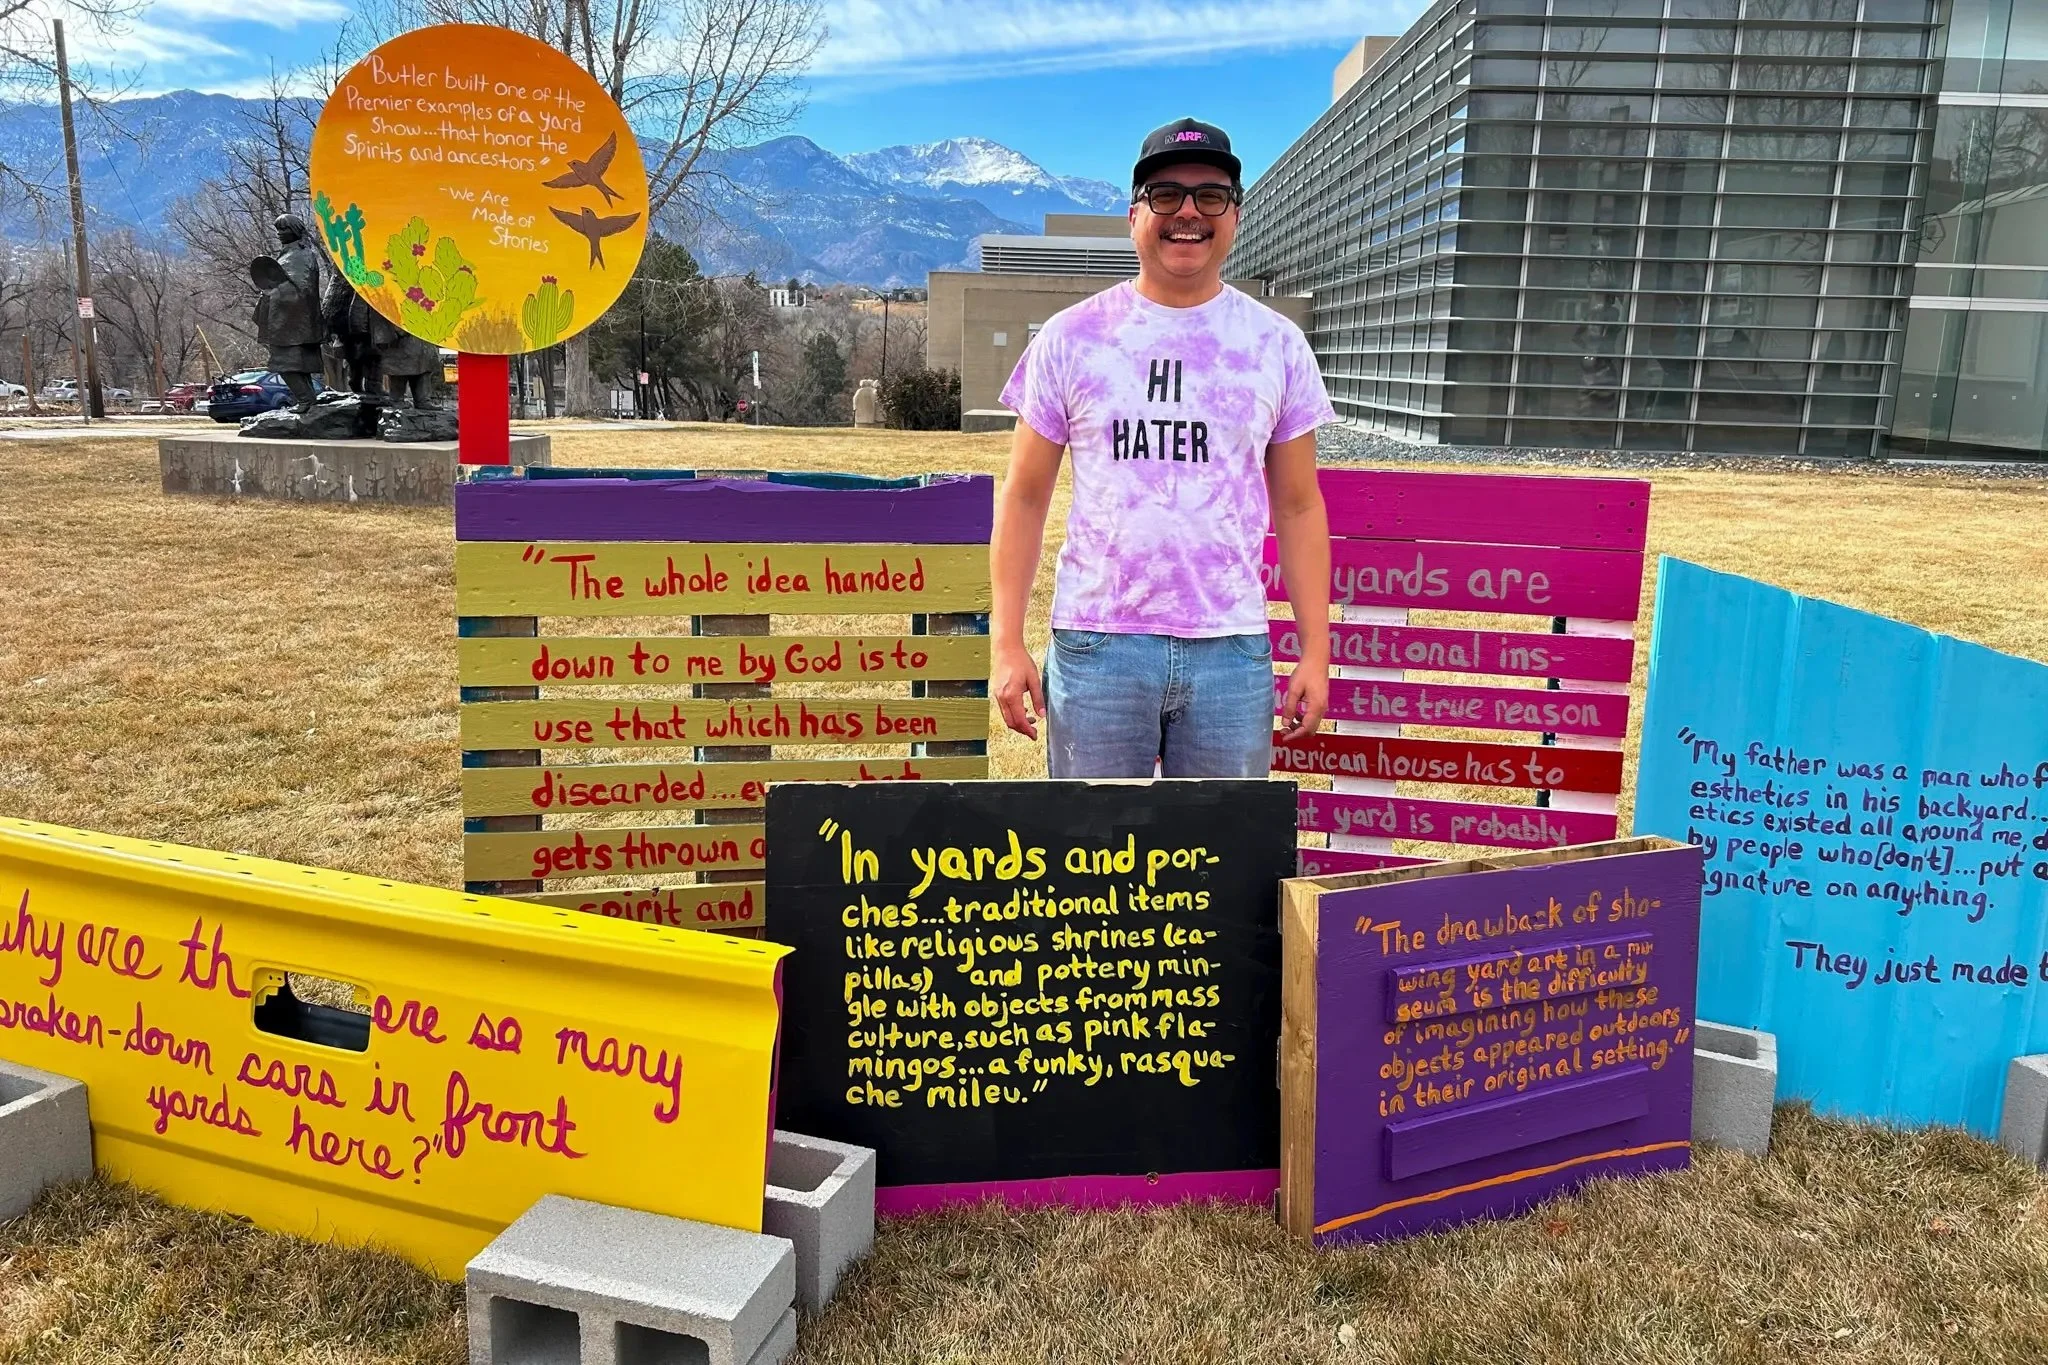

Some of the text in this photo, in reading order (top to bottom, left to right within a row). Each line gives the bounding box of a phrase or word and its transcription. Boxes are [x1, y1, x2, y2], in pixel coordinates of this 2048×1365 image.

[361, 54, 586, 112] "Butler built one of the
[346, 85, 412, 111] Premier
[417, 99, 492, 121] examples
[539, 112, 581, 133] yard
[344, 134, 550, 172] Spirits and ancestors."
[483, 128, 535, 148] honor
[537, 135, 568, 155] the
[1164, 131, 1210, 144] MARFA
[472, 207, 536, 229] Made of
[481, 189, 511, 207] Are
[488, 226, 550, 254] Stories
[1147, 359, 1182, 403] HI
[1112, 419, 1209, 463] HATER
[521, 544, 926, 601] "The whole idea handed
[1332, 551, 1450, 606] yards
[1466, 567, 1552, 604] are
[531, 644, 615, 682] down
[627, 641, 670, 675] to
[687, 653, 724, 678] me
[738, 642, 776, 683] by
[784, 643, 842, 676] God
[890, 640, 929, 669] to
[1500, 637, 1565, 671] ins-
[533, 701, 938, 744] use that which has been
[1418, 690, 1483, 721] true
[1495, 693, 1601, 728] reason
[1271, 741, 1565, 786] merican house has to
[1677, 726, 1736, 777] "My
[1744, 741, 1827, 776] father
[1837, 760, 1885, 781] was
[1893, 765, 1908, 780] a
[1922, 770, 1971, 788] man
[1690, 778, 1810, 807] esthetics
[1825, 784, 1848, 811] in
[1862, 787, 1901, 814] his
[1333, 800, 1397, 835] yard
[1409, 805, 1433, 834] is
[1450, 812, 1567, 846] probably
[1688, 805, 1755, 827] etics
[1762, 811, 1852, 836] existed
[1860, 816, 1893, 837] all
[1902, 819, 1983, 842] around
[1992, 832, 2028, 854] me,
[531, 833, 613, 879] gets
[617, 830, 740, 874] thrown
[817, 817, 1221, 900] "In yards and por-
[1688, 825, 1718, 861] by
[1726, 836, 1804, 869] people
[696, 886, 754, 923] and
[1127, 883, 1211, 914] items
[1700, 861, 1995, 924] ignature on anything.
[1354, 887, 1662, 955] "The drawback of sho-
[844, 932, 897, 960] like
[901, 929, 1040, 973] religious
[1051, 921, 1157, 954] shrines
[1784, 941, 1868, 990] They
[1874, 946, 1941, 986] just
[1952, 954, 2029, 987] made
[77, 923, 163, 980] are
[468, 1011, 522, 1054] so
[844, 949, 1223, 1004] pillas) and pottery min-
[1396, 960, 1648, 1023] seum is the difficulty
[1398, 967, 1456, 1003] wing
[1464, 950, 1523, 994] yard
[1528, 948, 1568, 973] art
[1576, 944, 1595, 966] in
[1603, 943, 1621, 961] a
[846, 984, 1221, 1029] gle with objects from mass
[1383, 985, 1659, 1048] of imagining how these
[1036, 1023, 1073, 1045] as
[1084, 1011, 1152, 1052] pink
[1156, 1011, 1217, 1040] fla-
[1379, 1006, 1681, 1092] objects appeared outdoors
[1014, 1049, 1113, 1087] funky,
[1120, 1049, 1237, 1087] rasqua-
[1378, 1029, 1690, 1117] in their original setting."
[146, 1083, 262, 1139] yards
[236, 1049, 347, 1109] cars
[363, 1061, 417, 1123] in
[439, 1069, 590, 1162] front
[845, 1084, 903, 1108] che
